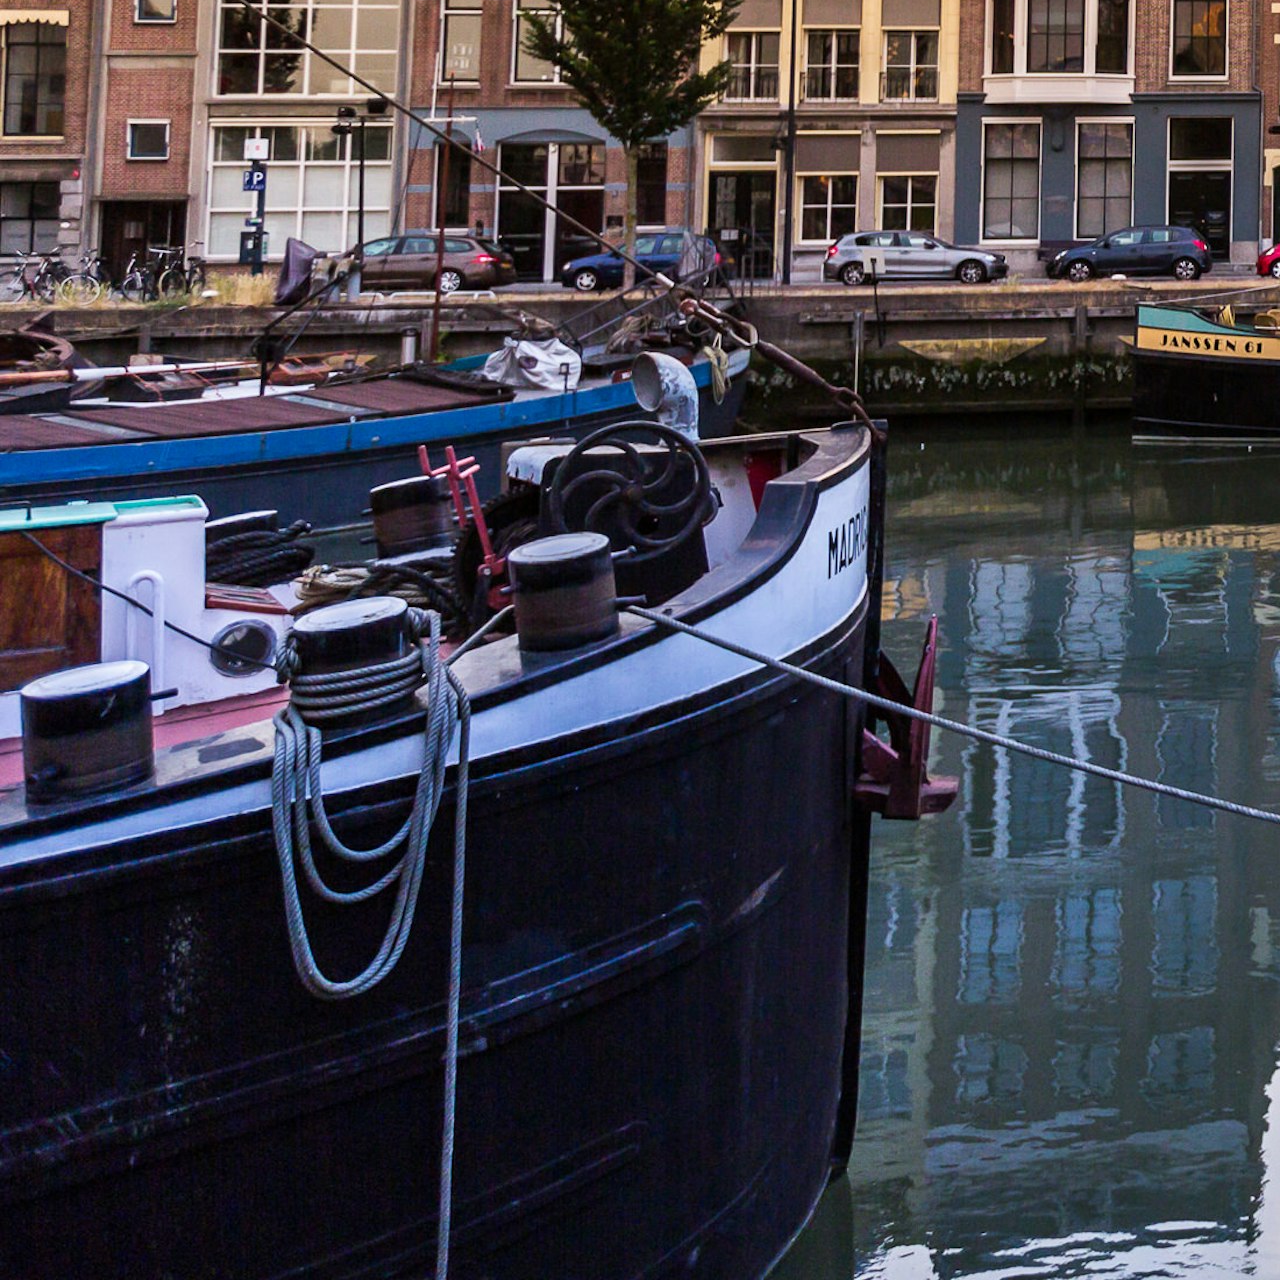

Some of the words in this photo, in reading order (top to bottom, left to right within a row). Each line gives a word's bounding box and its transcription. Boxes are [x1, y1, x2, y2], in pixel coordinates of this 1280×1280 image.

[253, 171, 264, 185] P
[1160, 334, 1237, 352] JANSSEN
[1244, 340, 1263, 354] 61
